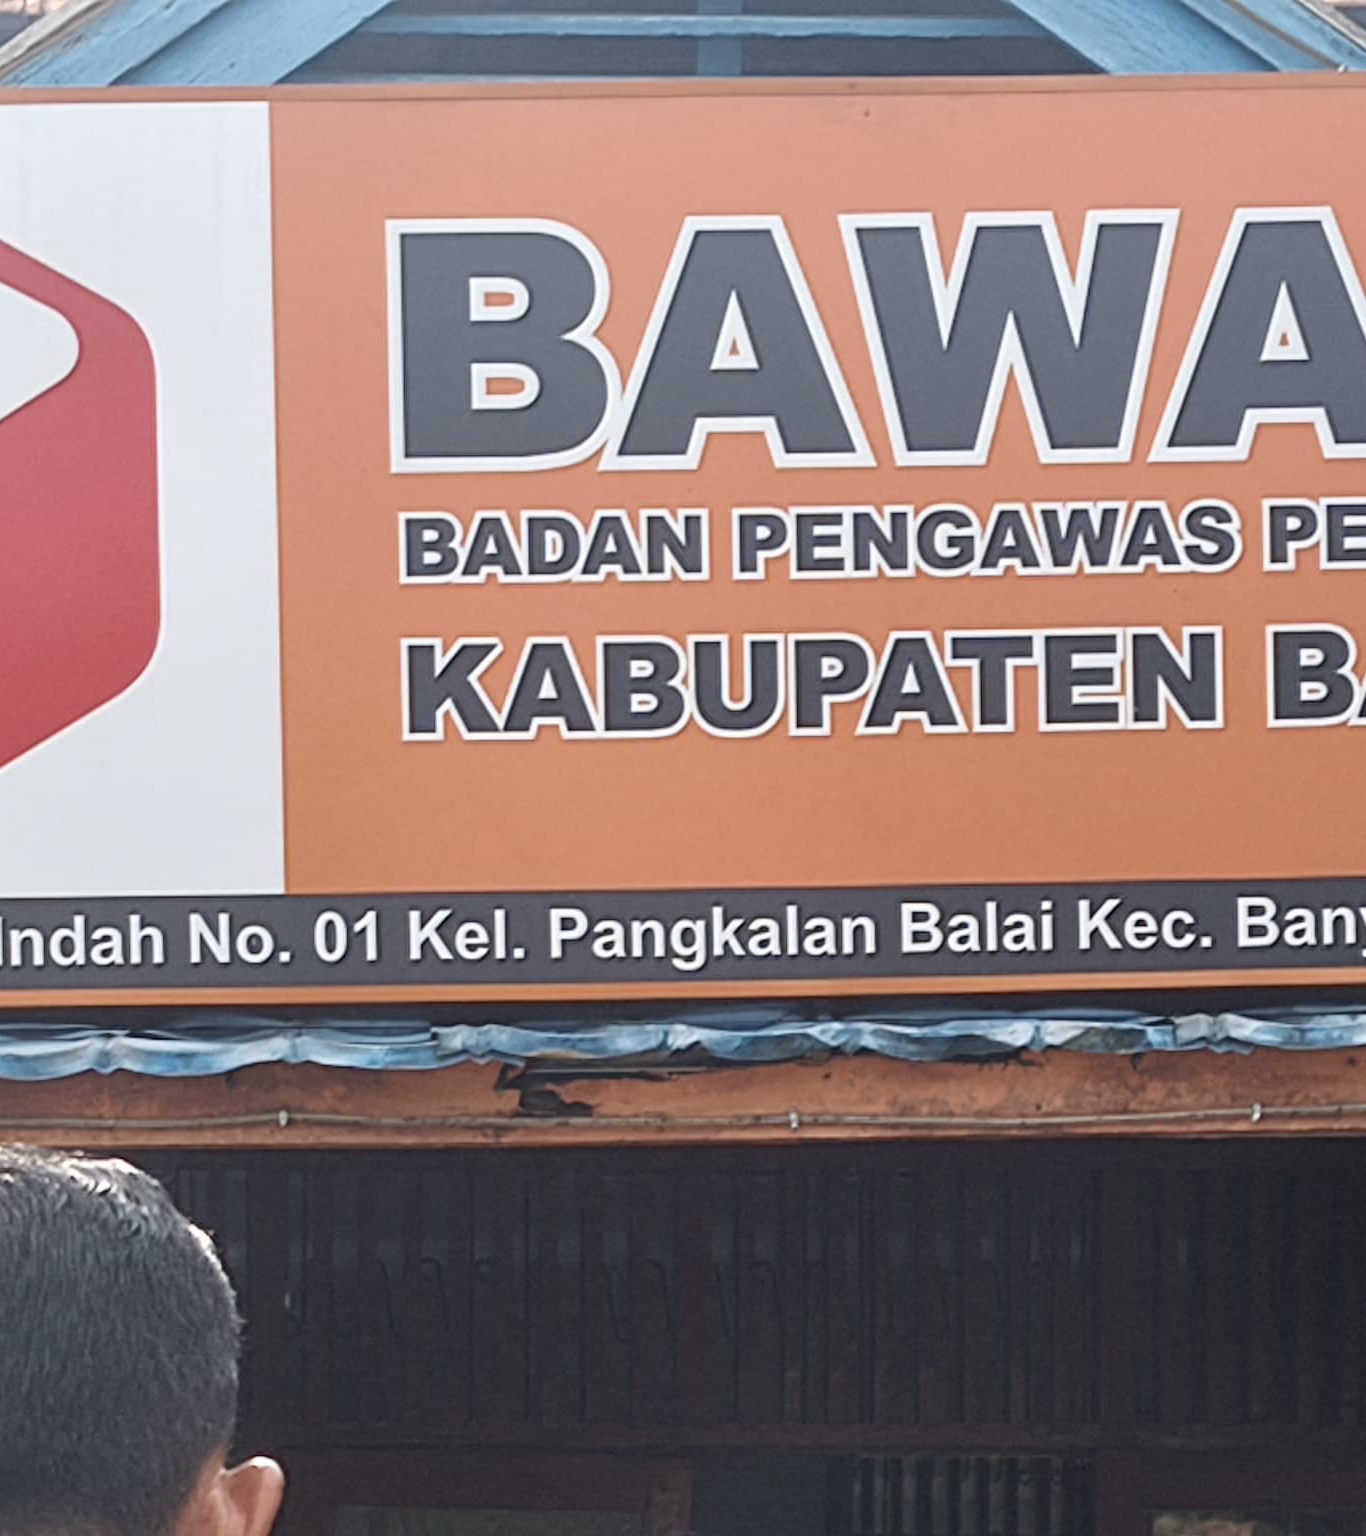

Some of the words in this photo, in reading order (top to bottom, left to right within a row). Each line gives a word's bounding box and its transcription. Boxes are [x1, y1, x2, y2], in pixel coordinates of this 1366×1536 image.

[398, 508, 709, 584] BADAN
[731, 499, 1242, 580] PENGAWAS
[400, 626, 1223, 741] KABUPATEN
[188, 912, 291, 964] No.
[313, 910, 377, 962] 01
[408, 908, 525, 960] Kel.
[549, 904, 876, 971] Pangkalan
[900, 900, 1053, 953] Balai
[1077, 898, 1212, 950] Kec.
